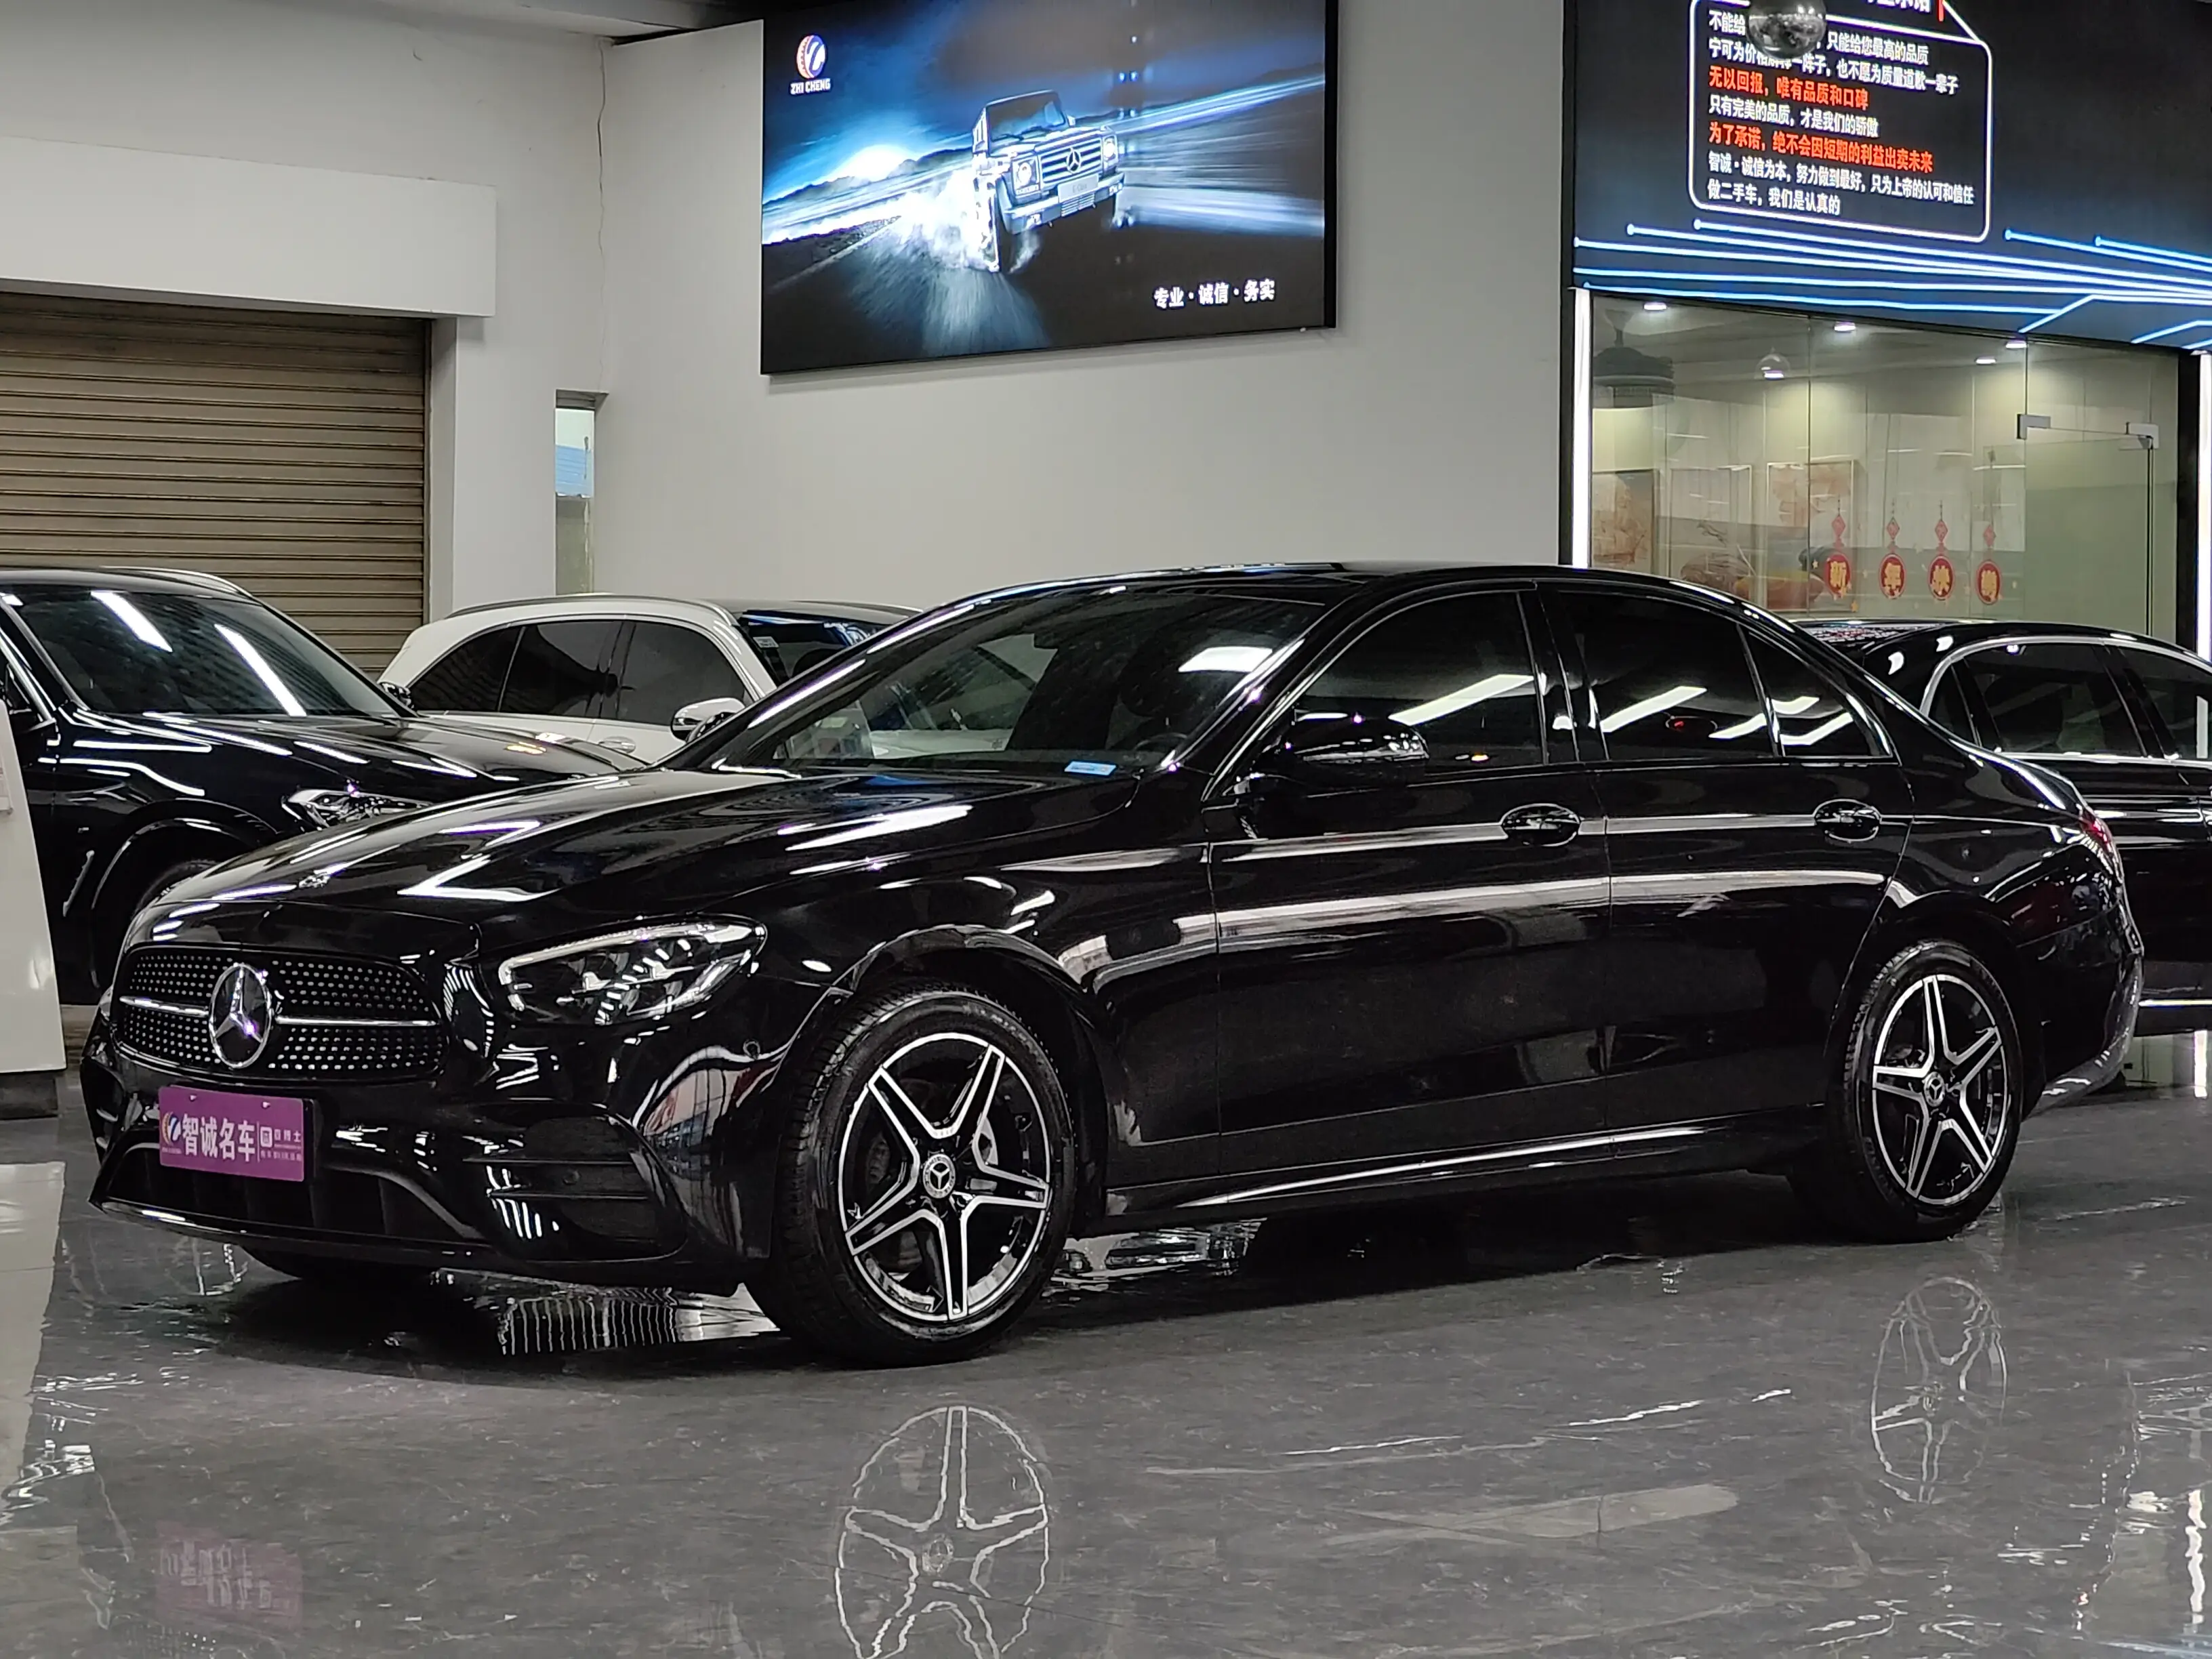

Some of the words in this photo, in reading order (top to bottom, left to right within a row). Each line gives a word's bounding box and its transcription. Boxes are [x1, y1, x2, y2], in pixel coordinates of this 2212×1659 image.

[790, 82, 804, 94] ZHI
[805, 79, 831, 93] CHENG
[1709, 66, 1869, 110] 无以回报，唯有品质和口碑
[1708, 179, 1841, 215] 做二手车，我们是认真的
[182, 1113, 255, 1162] 智诚名车
